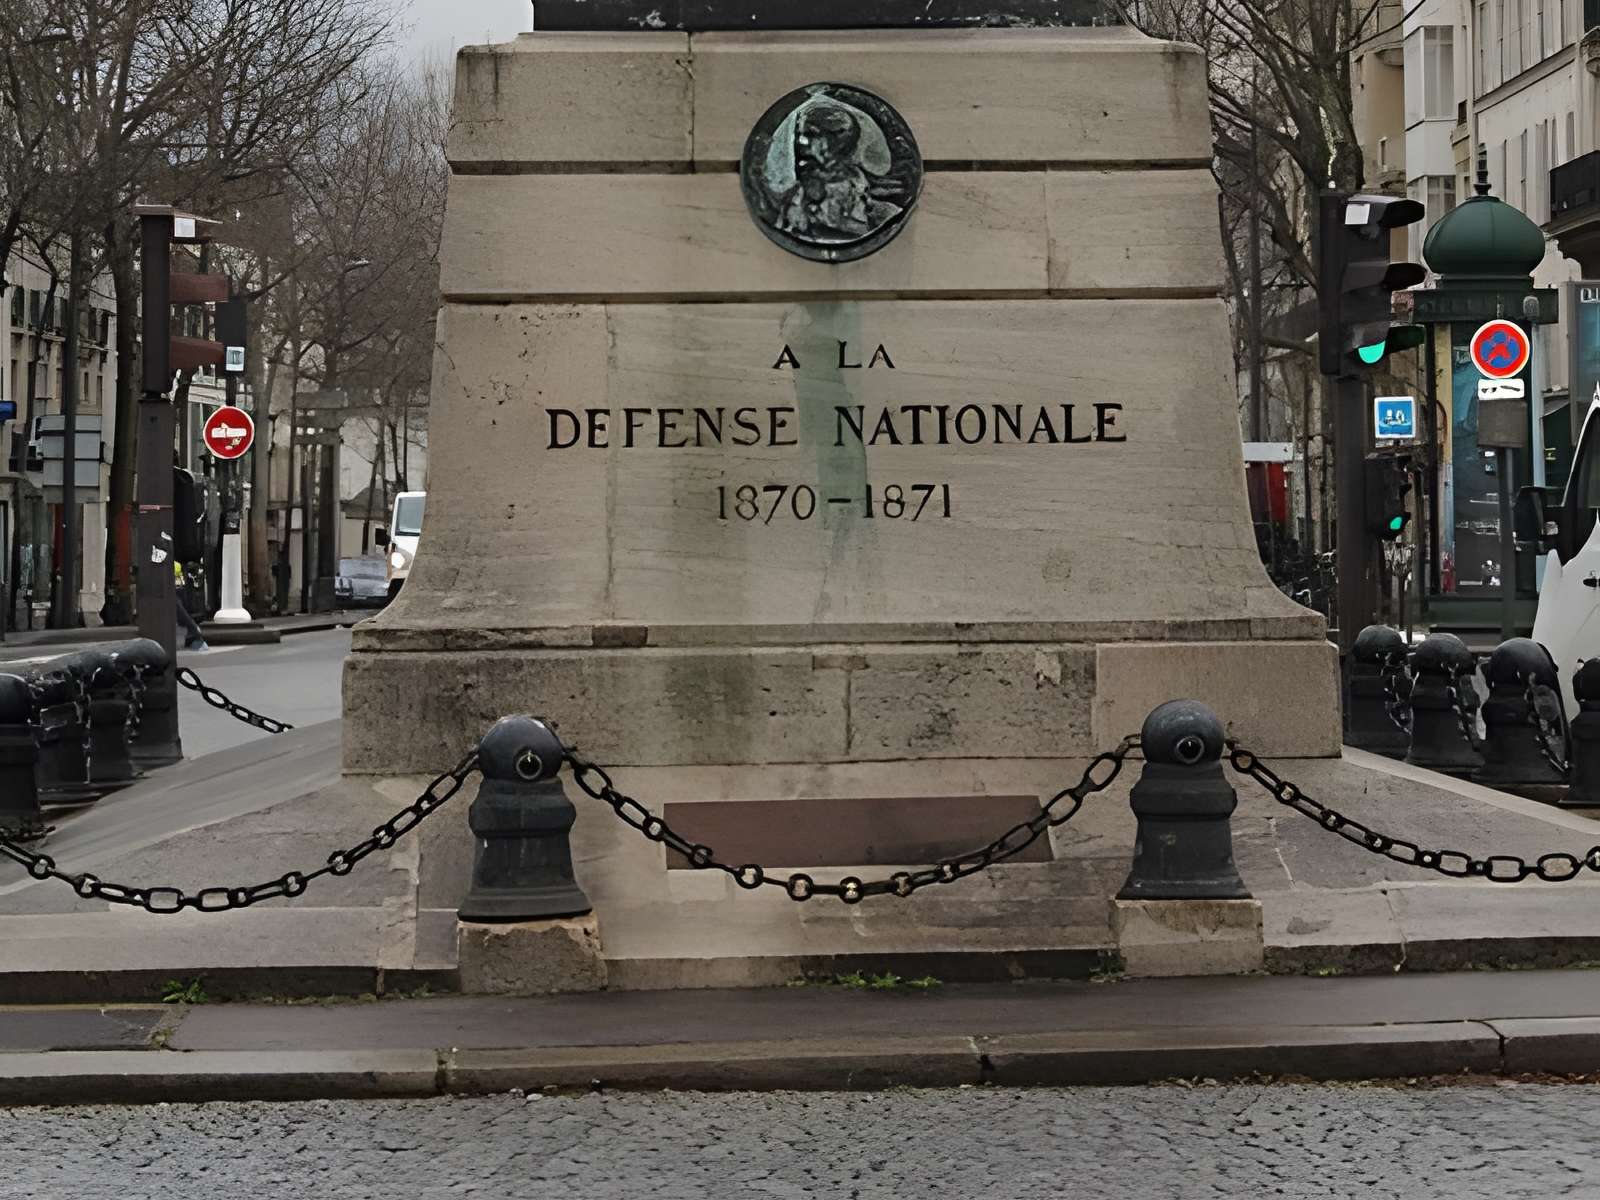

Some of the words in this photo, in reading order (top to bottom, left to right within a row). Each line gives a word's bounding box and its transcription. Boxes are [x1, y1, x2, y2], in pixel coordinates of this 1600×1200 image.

[772, 344, 801, 369] A
[838, 341, 895, 369] LA
[546, 407, 798, 449] DEFENSE
[834, 403, 1126, 446] NATIONALE
